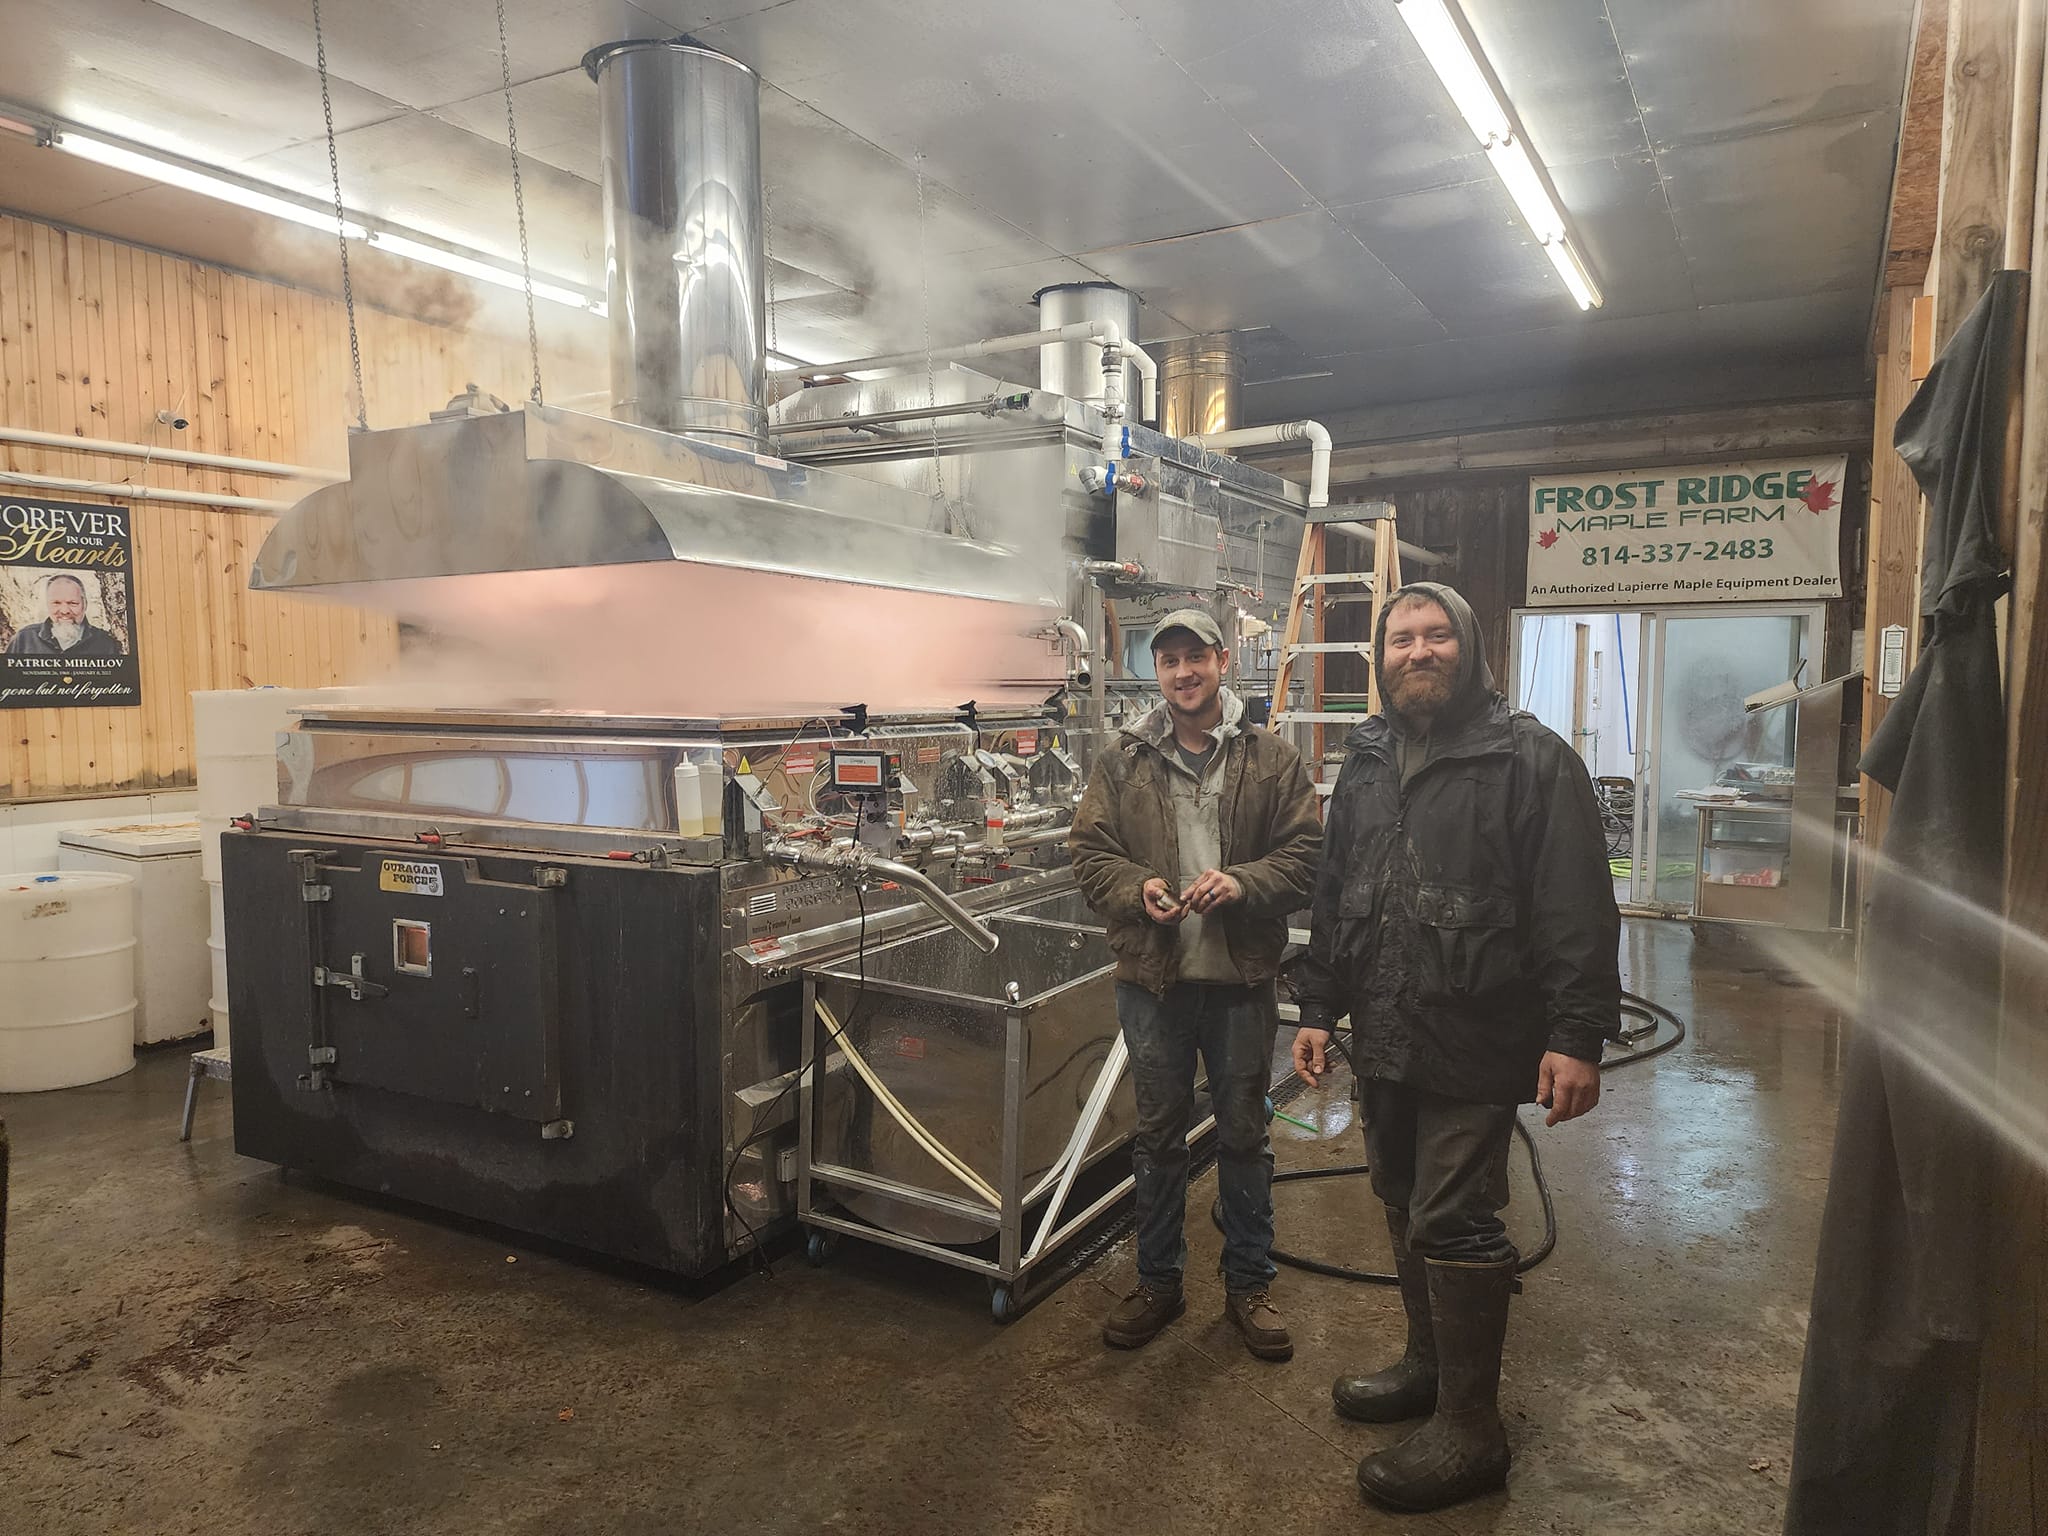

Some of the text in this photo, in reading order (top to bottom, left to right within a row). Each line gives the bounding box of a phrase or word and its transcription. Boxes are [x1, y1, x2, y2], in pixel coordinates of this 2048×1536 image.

[1535, 469, 1812, 514] FROST RIDGE
[0, 504, 127, 537] OREVER
[1556, 505, 1784, 533] MAPLE FARM
[0, 522, 127, 567] Hearts
[66, 535, 103, 546] IN OUR
[1582, 538, 1774, 566] 814-337-2483
[1531, 575, 1838, 595] An Authorized Lapierre Maple Equipment Dealer
[7, 658, 124, 668] PATRICK MIHAILOV
[0, 681, 133, 701] gone but not forgotten
[383, 862, 438, 876] OURAGAN
[392, 873, 439, 893] FORCE 5
